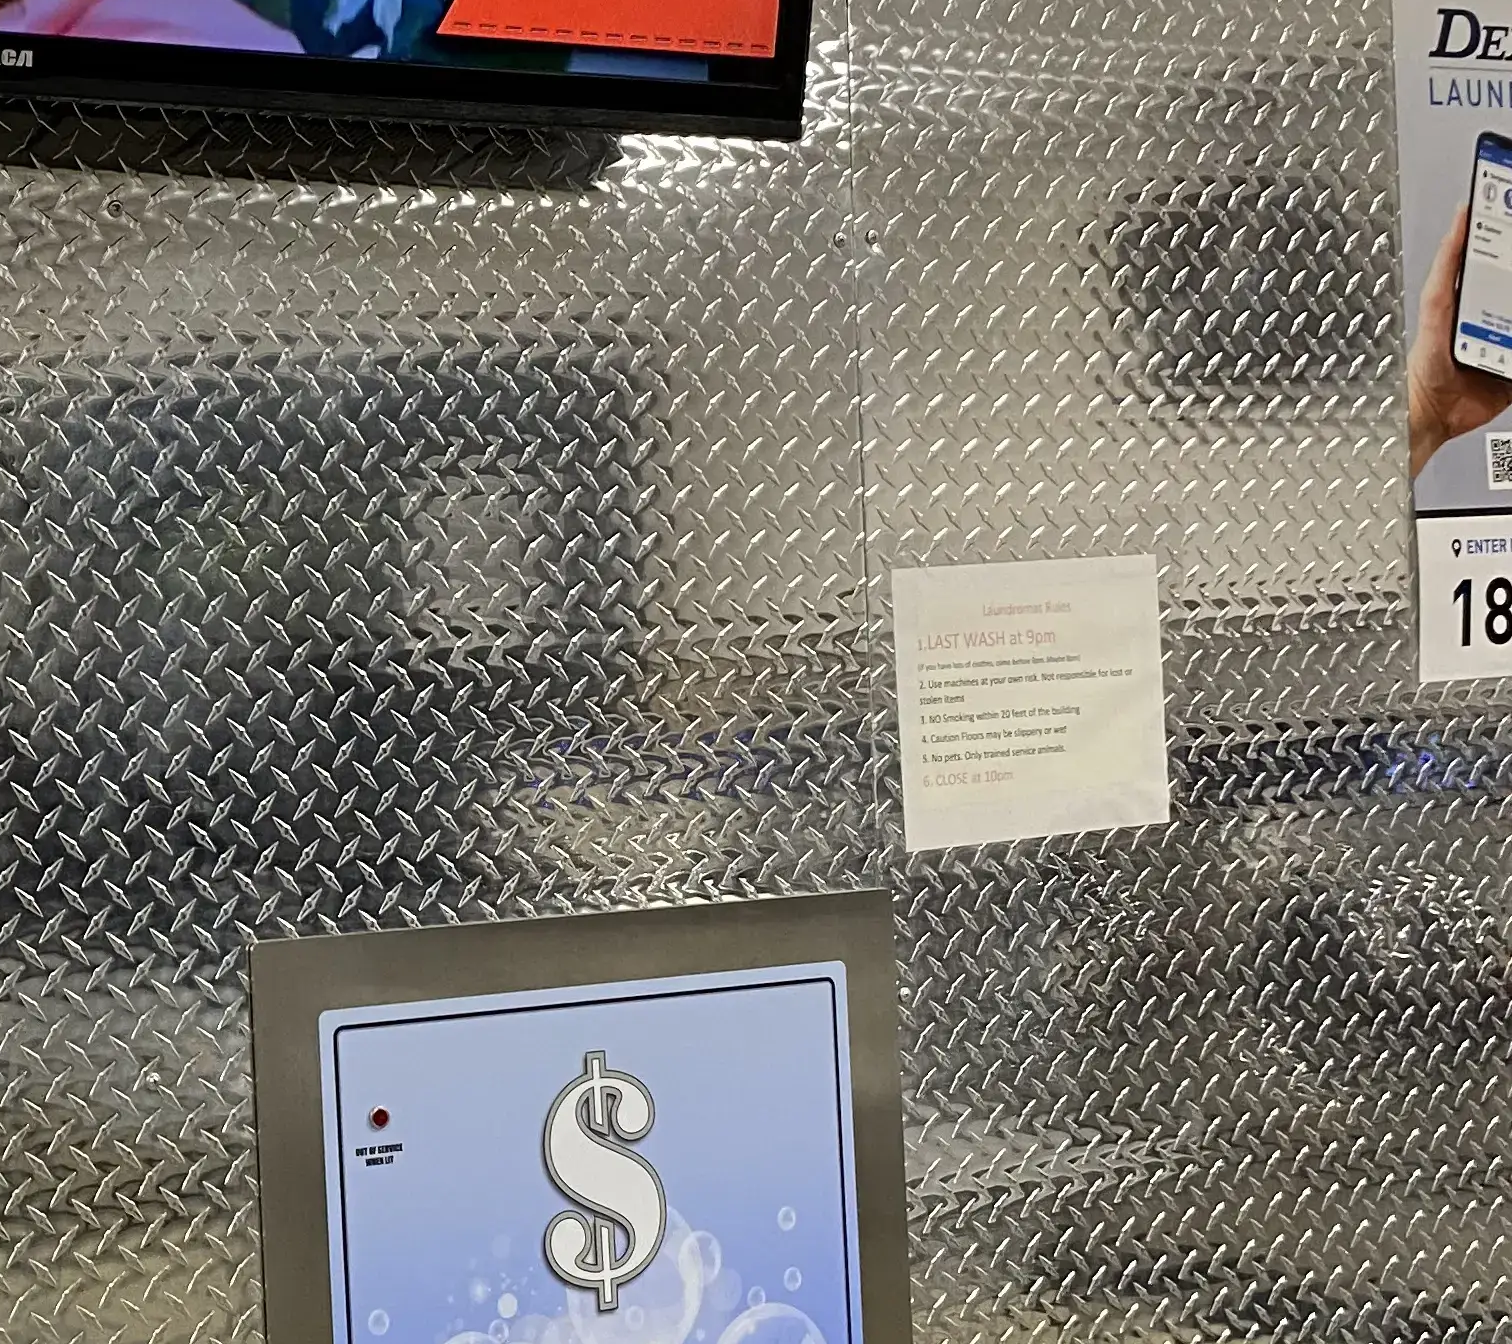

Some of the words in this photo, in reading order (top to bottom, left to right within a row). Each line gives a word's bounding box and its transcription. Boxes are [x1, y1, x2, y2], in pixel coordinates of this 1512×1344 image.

[1428, 8, 1512, 61] DE
[1429, 77, 1512, 109] LAUN
[1467, 539, 1507, 554] ENTER
[963, 631, 1005, 648] WASH
[1009, 632, 1022, 645] at
[1026, 629, 1056, 646] 9pm
[928, 680, 942, 689] Use
[944, 678, 978, 688] machines
[990, 677, 1006, 687] your
[1008, 675, 1023, 683] own
[1041, 673, 1054, 681] Not
[1056, 670, 1096, 680] responsible
[1098, 669, 1108, 677] for
[1110, 668, 1123, 676] lost
[920, 696, 942, 705] stolen
[944, 695, 965, 703] items
[943, 712, 975, 723] Smoking
[976, 711, 999, 721] within
[1001, 710, 1010, 719] 20
[1012, 708, 1026, 718] feet
[1028, 707, 1037, 717] of
[1038, 706, 1050, 716] the
[1052, 705, 1080, 716] building
[931, 733, 960, 743] Caution
[961, 731, 984, 741] Floors
[986, 730, 1001, 740] may
[1003, 728, 1012, 738] be
[1014, 727, 1042, 738] slippery
[1044, 726, 1052, 735] or
[1054, 725, 1067, 734] wet
[932, 754, 942, 762] No
[965, 751, 982, 761] Only
[984, 748, 1010, 758] trained
[1012, 747, 1036, 757] service
[936, 772, 968, 786] CLOSE
